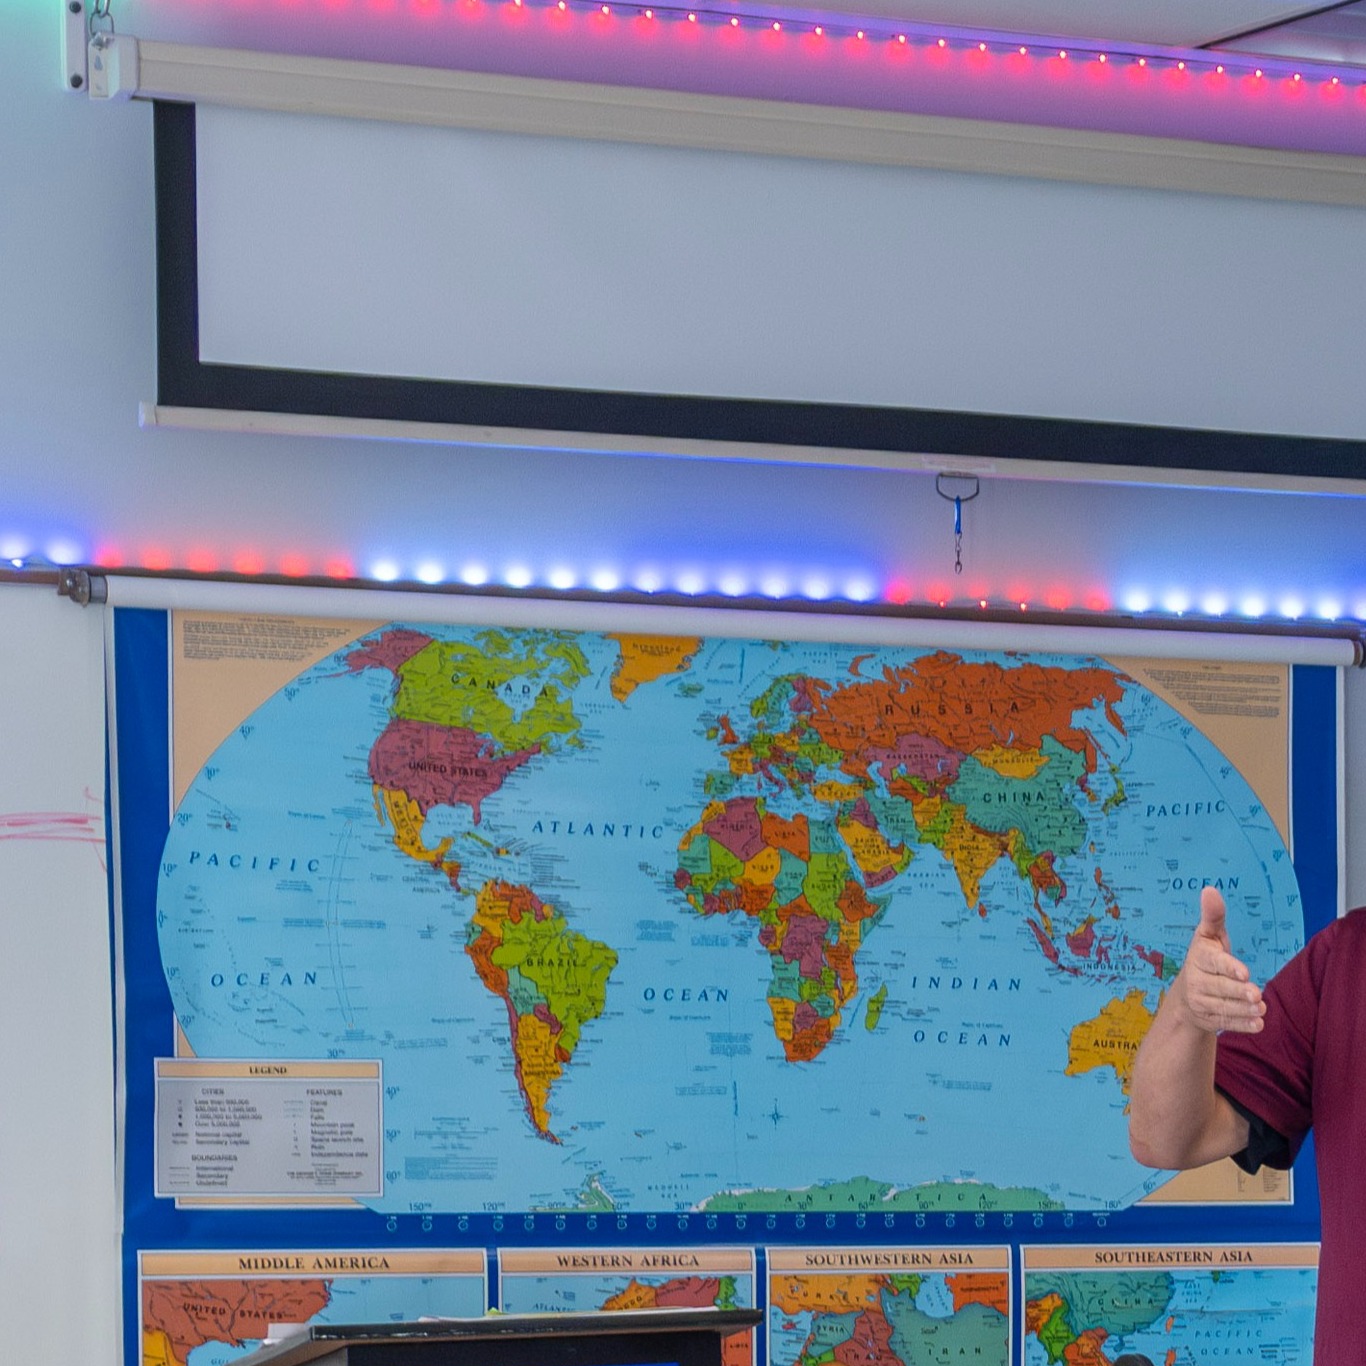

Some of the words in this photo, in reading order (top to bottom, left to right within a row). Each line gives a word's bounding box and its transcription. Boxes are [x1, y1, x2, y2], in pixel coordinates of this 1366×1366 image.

[450, 673, 550, 698] CANADA
[884, 701, 1022, 716] RUSSIA
[408, 761, 447, 774] UNITED
[450, 765, 488, 778] STATES
[982, 790, 1047, 804] CHINA
[1146, 800, 1227, 817] PACIFIC
[531, 819, 664, 839] ATLANTIC
[189, 850, 320, 873] PACIFIC
[1171, 877, 1240, 891] OCEAN
[526, 957, 578, 969] BRAZIL
[210, 970, 318, 987] OCEAN
[910, 976, 1022, 992] INDIAN
[643, 987, 729, 1002] OCEAN
[913, 1030, 1013, 1047] OCEAN
[249, 1066, 287, 1075] LEGEND
[239, 1257, 305, 1271] MIDDLE
[312, 1256, 390, 1270] AMERICA
[557, 1254, 633, 1268] WESTERN
[641, 1254, 700, 1267] AFRICA
[805, 1252, 934, 1267] SOUTHWESTERN
[939, 1252, 974, 1266] ASIA
[1094, 1250, 1215, 1264] SOUTHEASTERN
[1219, 1250, 1253, 1263] ASIA
